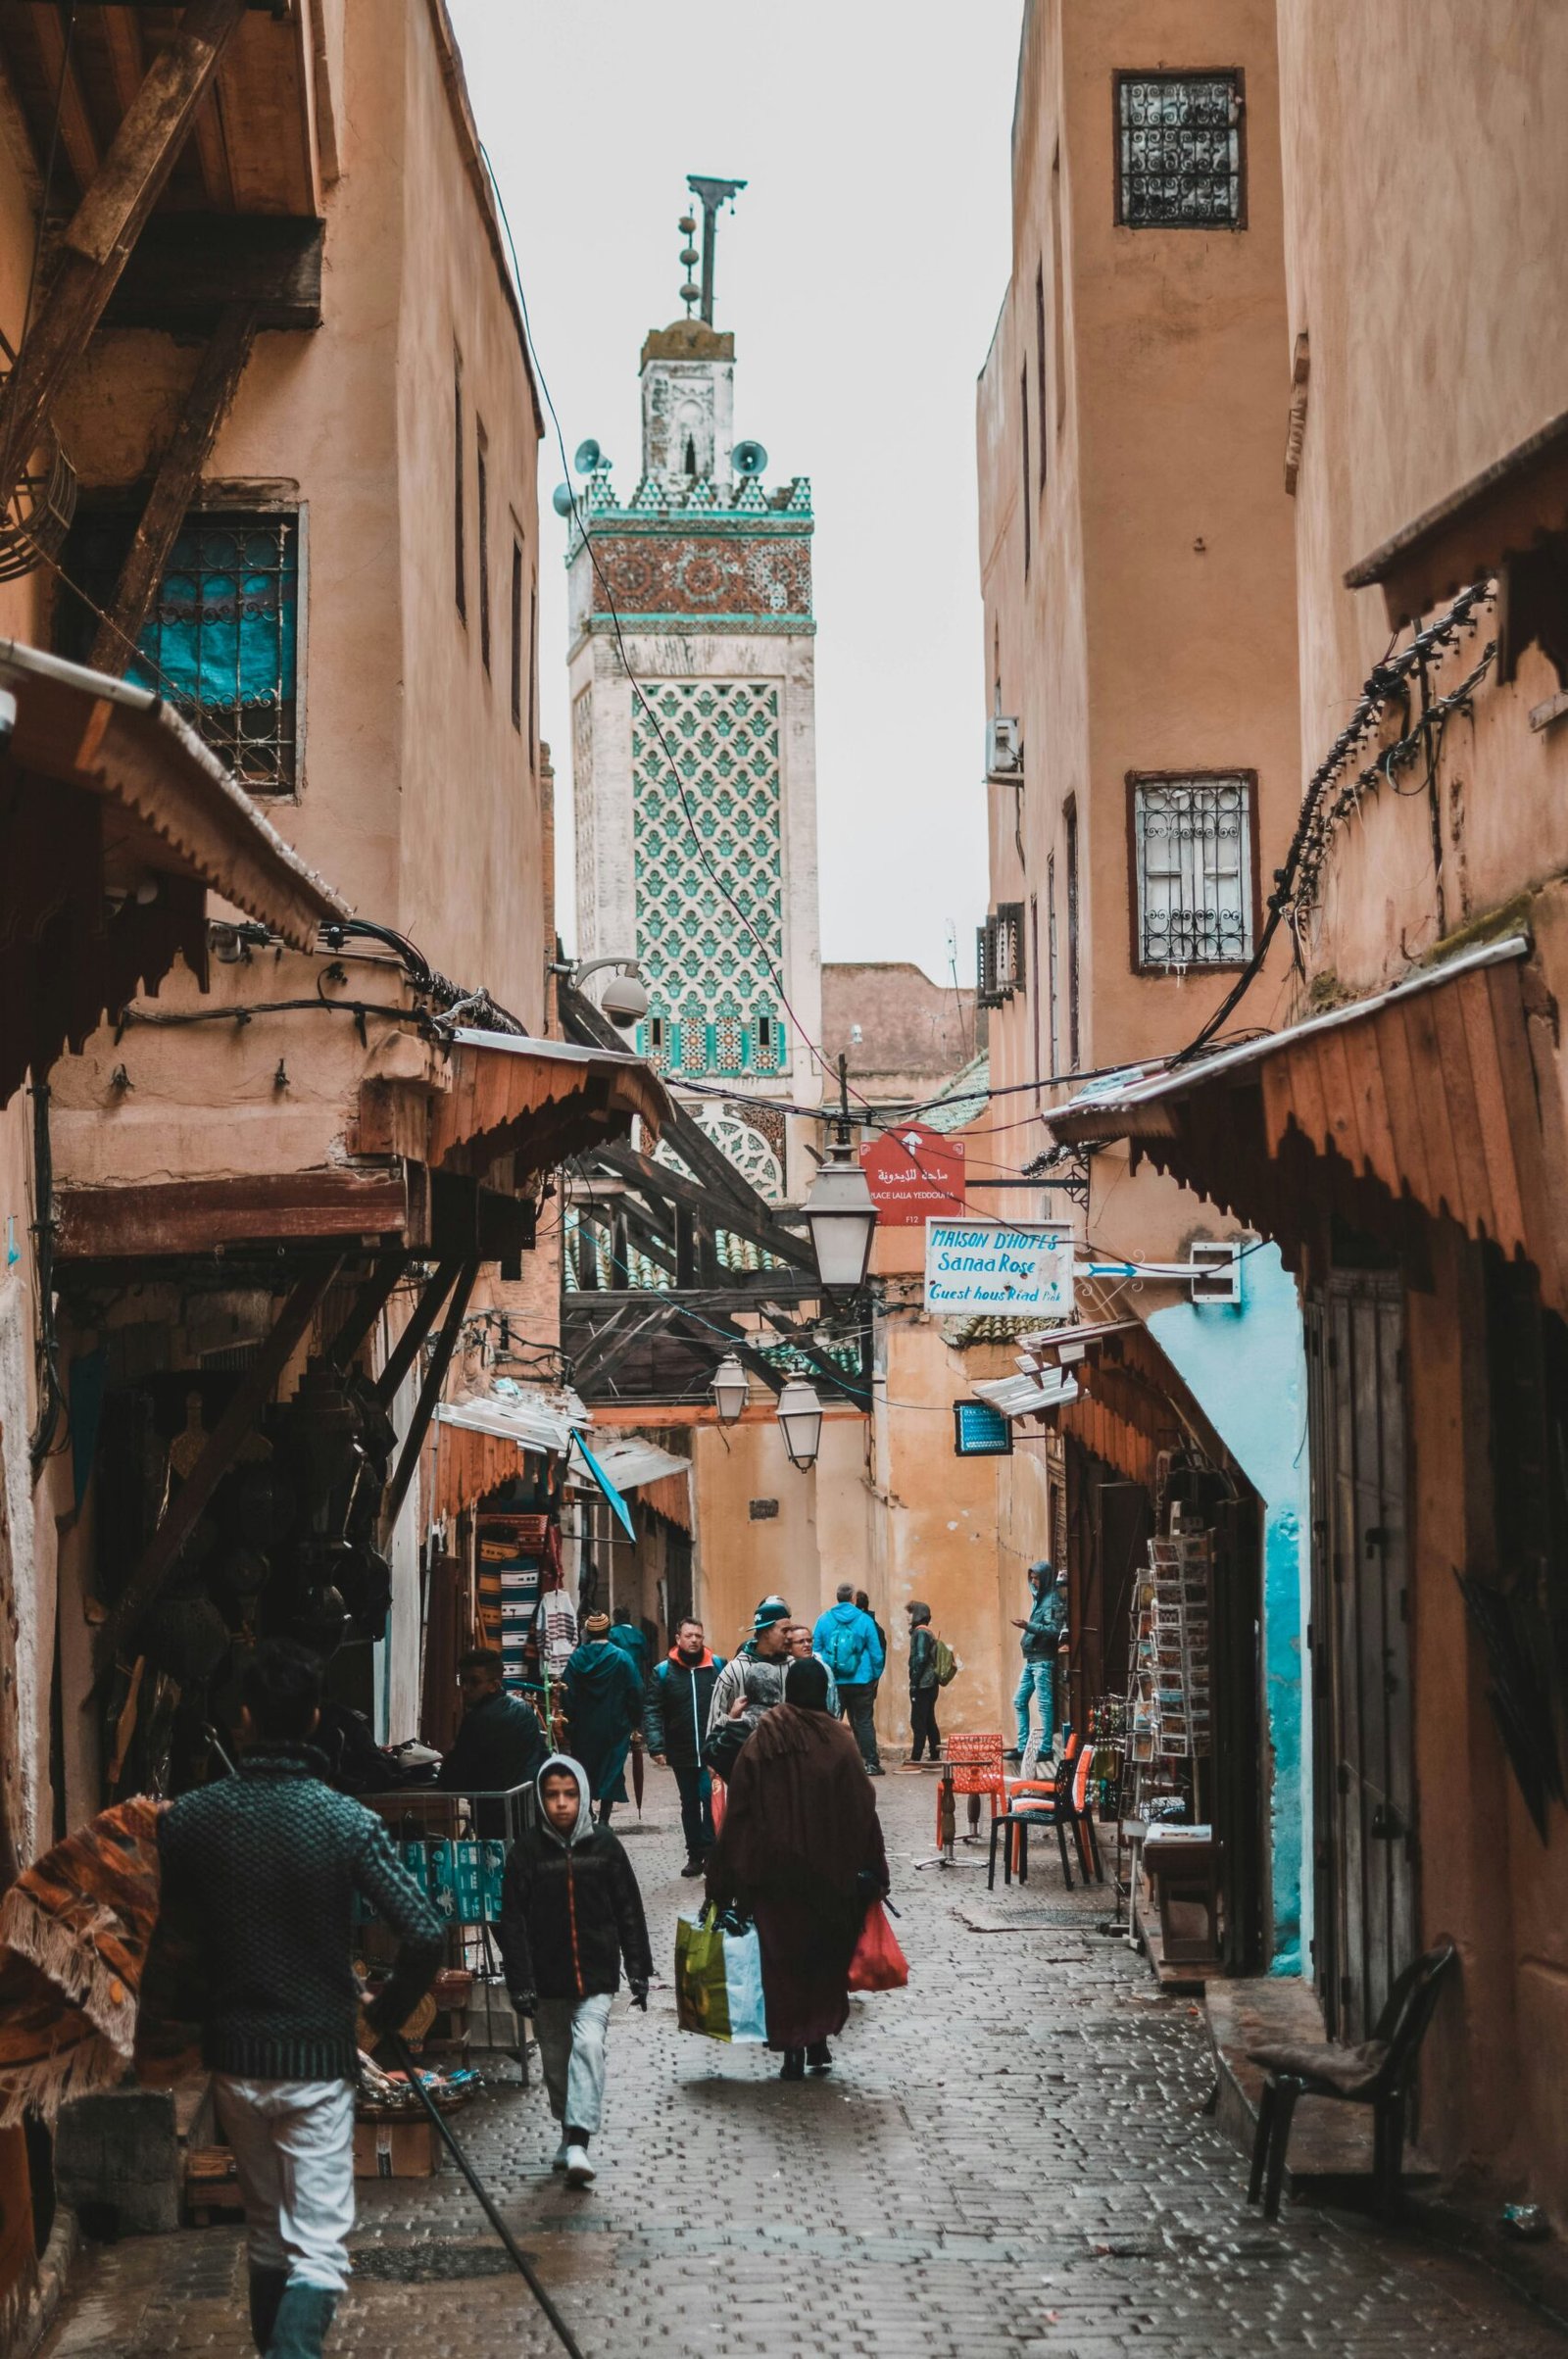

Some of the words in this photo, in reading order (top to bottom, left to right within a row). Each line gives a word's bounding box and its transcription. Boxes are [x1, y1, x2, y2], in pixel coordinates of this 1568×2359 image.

[906, 1215, 919, 1224] F12
[932, 1229, 990, 1248] MAISON
[994, 1232, 1059, 1251] D'HOTES
[938, 1253, 996, 1272] Sanaa
[998, 1253, 1036, 1274] Rose
[929, 1283, 972, 1301] Guest
[1007, 1286, 1040, 1302] Riad
